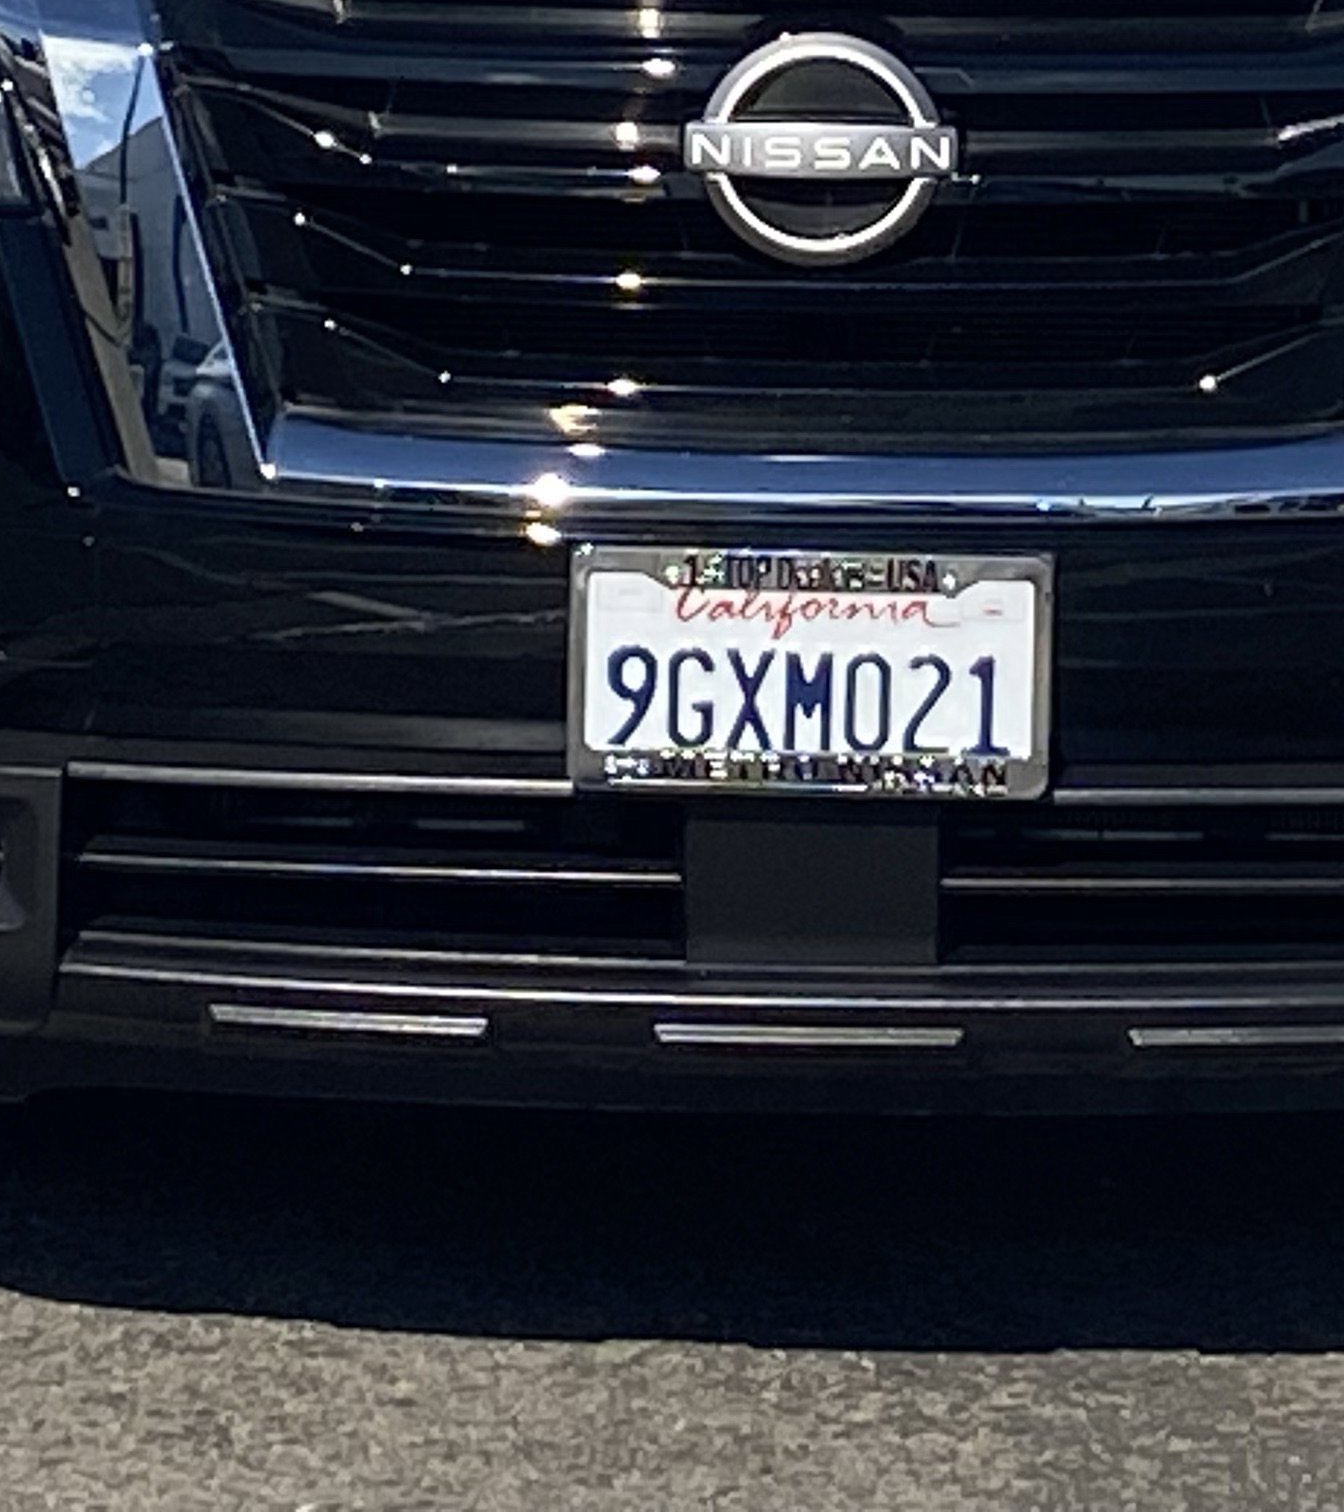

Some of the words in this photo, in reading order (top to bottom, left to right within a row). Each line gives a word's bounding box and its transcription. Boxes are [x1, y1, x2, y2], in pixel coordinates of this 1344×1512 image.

[690, 133, 952, 171] NISSAN
[675, 587, 960, 640] California
[607, 644, 1010, 756] 9GXM021
